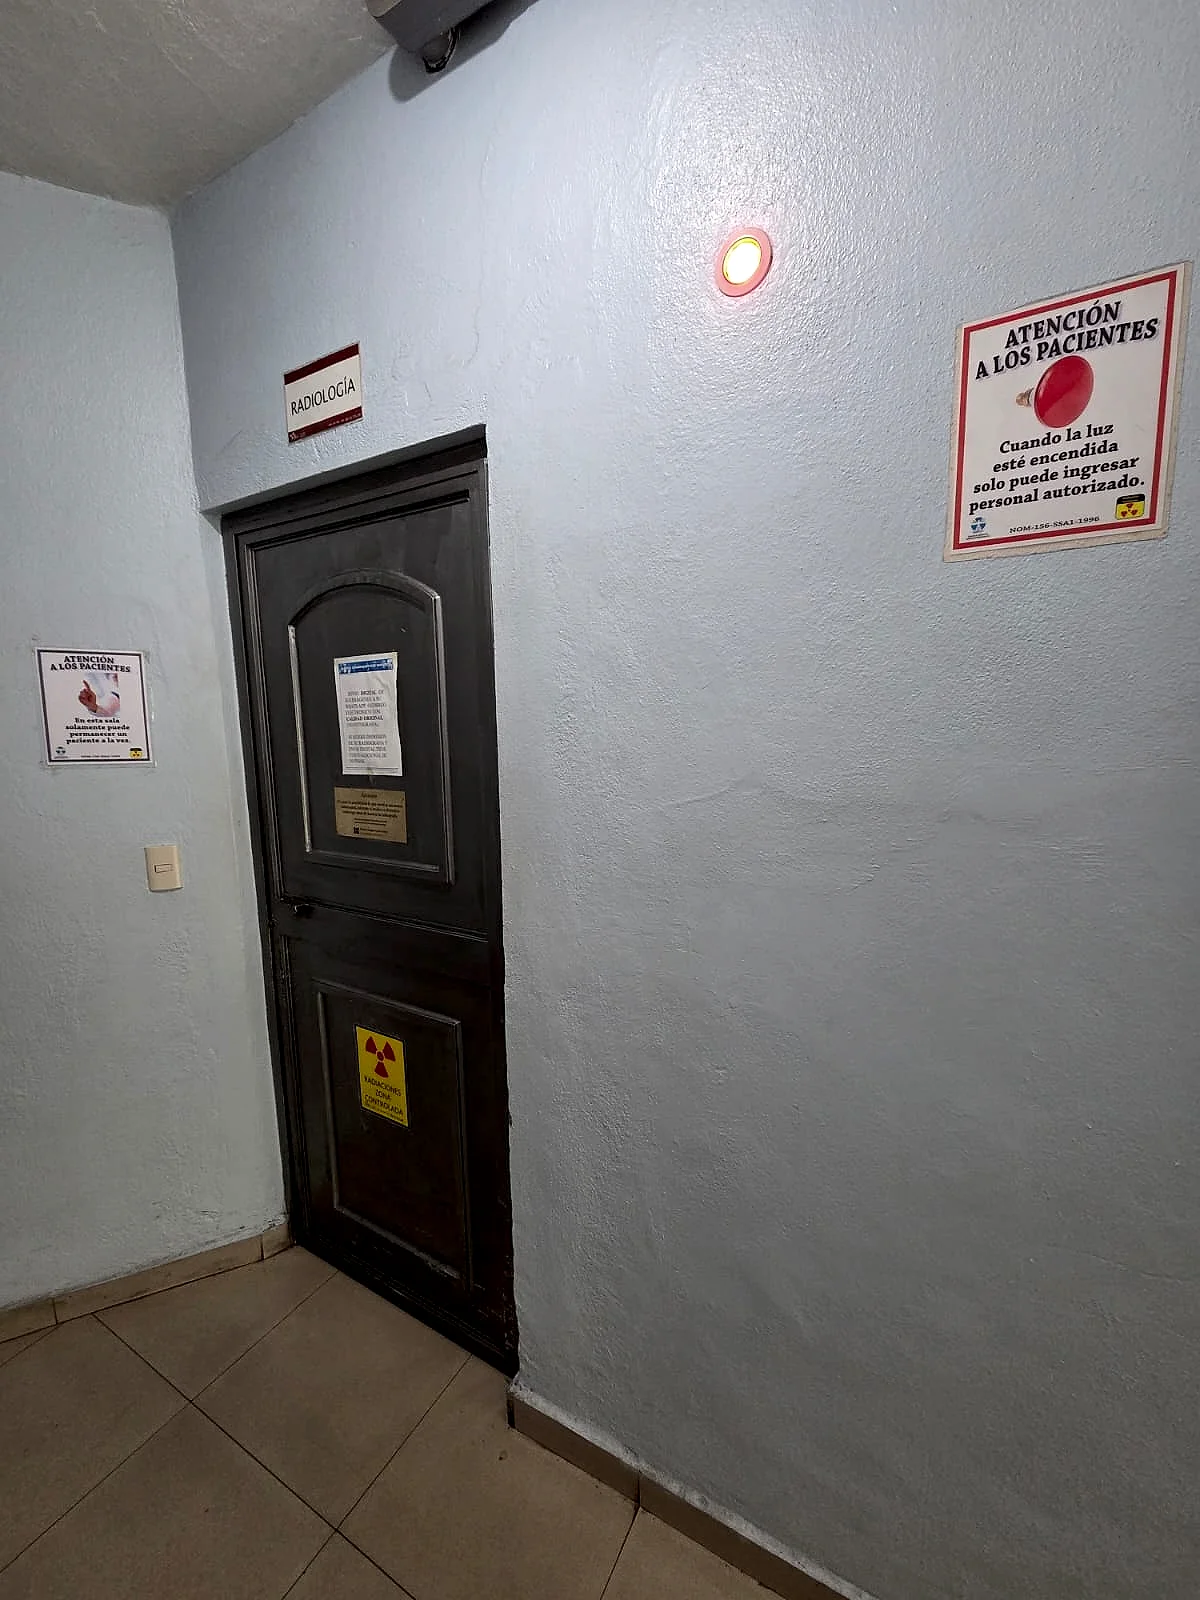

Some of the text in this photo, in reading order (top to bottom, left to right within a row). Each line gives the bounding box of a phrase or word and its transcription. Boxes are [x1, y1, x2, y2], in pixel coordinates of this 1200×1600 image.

[1004, 300, 1122, 349] ATENCIÓN
[975, 318, 1159, 380] A LOS PACIENTES
[291, 376, 355, 416] RADIOLOGÍA
[999, 423, 1114, 454] Cuando la luz
[992, 441, 1119, 473] esté encendida
[973, 456, 1139, 494] solo puede ingresar
[969, 475, 1145, 515] personal autorizado.
[1009, 517, 1100, 534] NOM-156-SSA1-1996
[64, 655, 114, 663] ATENCIÓN
[80, 663, 131, 672] PACIENTES
